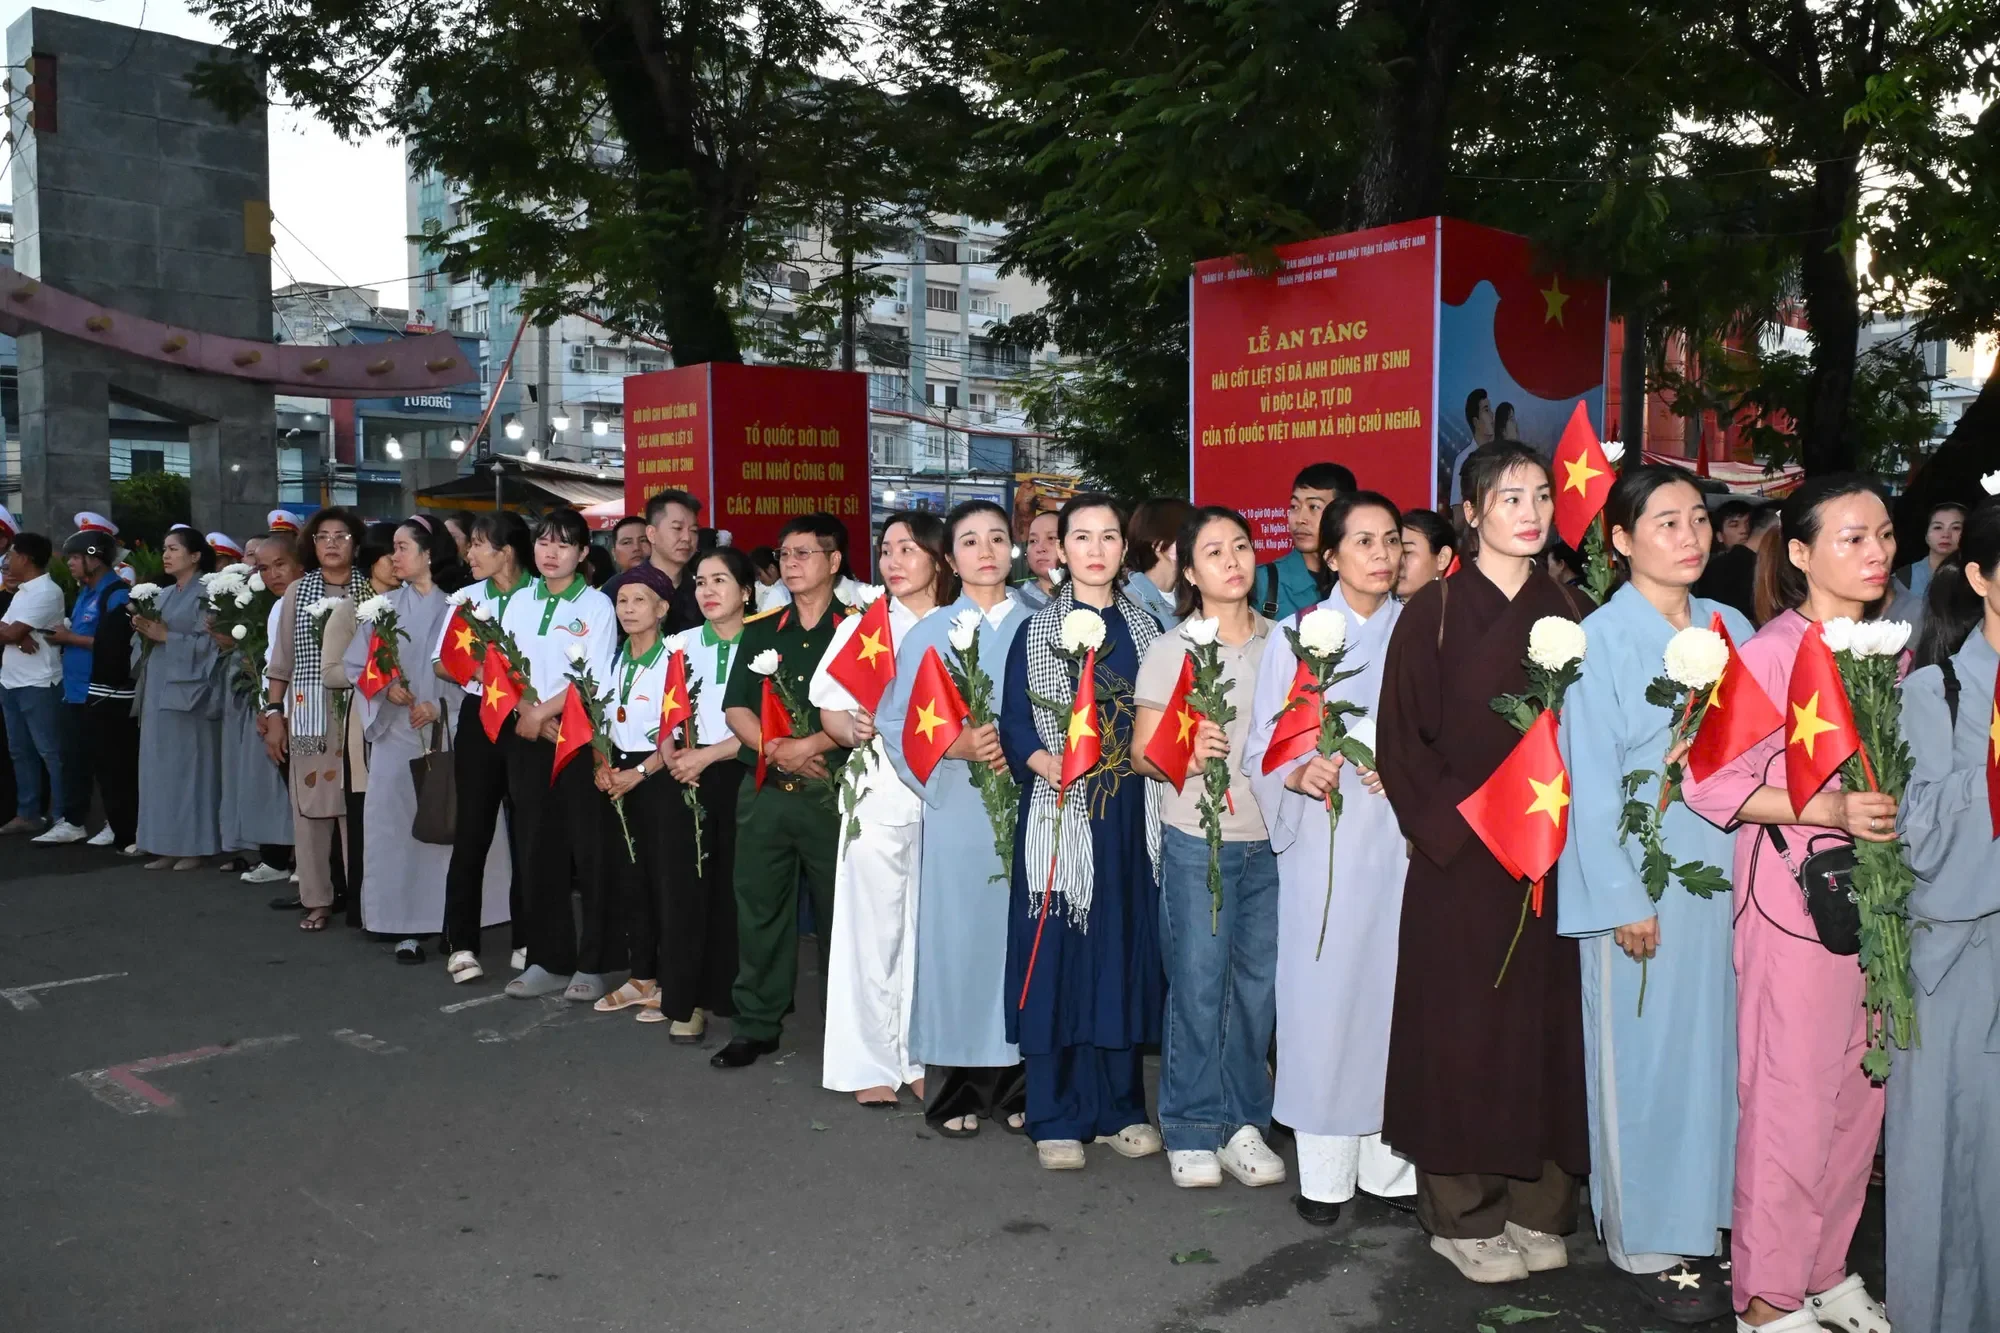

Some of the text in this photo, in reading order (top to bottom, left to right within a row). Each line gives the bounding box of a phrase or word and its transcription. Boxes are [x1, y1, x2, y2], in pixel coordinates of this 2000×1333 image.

[1400, 237, 1411, 250] VIỆT
[1412, 235, 1426, 247] NAM
[1248, 320, 1368, 354] LỄ AN TÁNG
[1212, 349, 1410, 390] HÀI CỐT LIỆT SĨ ĐÃ ANH DŨNG HY SINH
[404, 396, 452, 409] TUBORG
[1260, 387, 1352, 415] VÌ ĐỘC LẬP, TỰ DO
[744, 420, 840, 448] TỔ QUỐC ĐỜI ĐỜI
[1202, 406, 1421, 447] CỦA TỔ QUỐC VIỆT NAM XÃ HỘI CHỦ NGHĨA
[742, 458, 844, 480] GHI NHỚ CÔNG ƠN
[726, 492, 751, 514] CÁC
[755, 496, 780, 514] ANH
[783, 494, 815, 514] HÙNG
